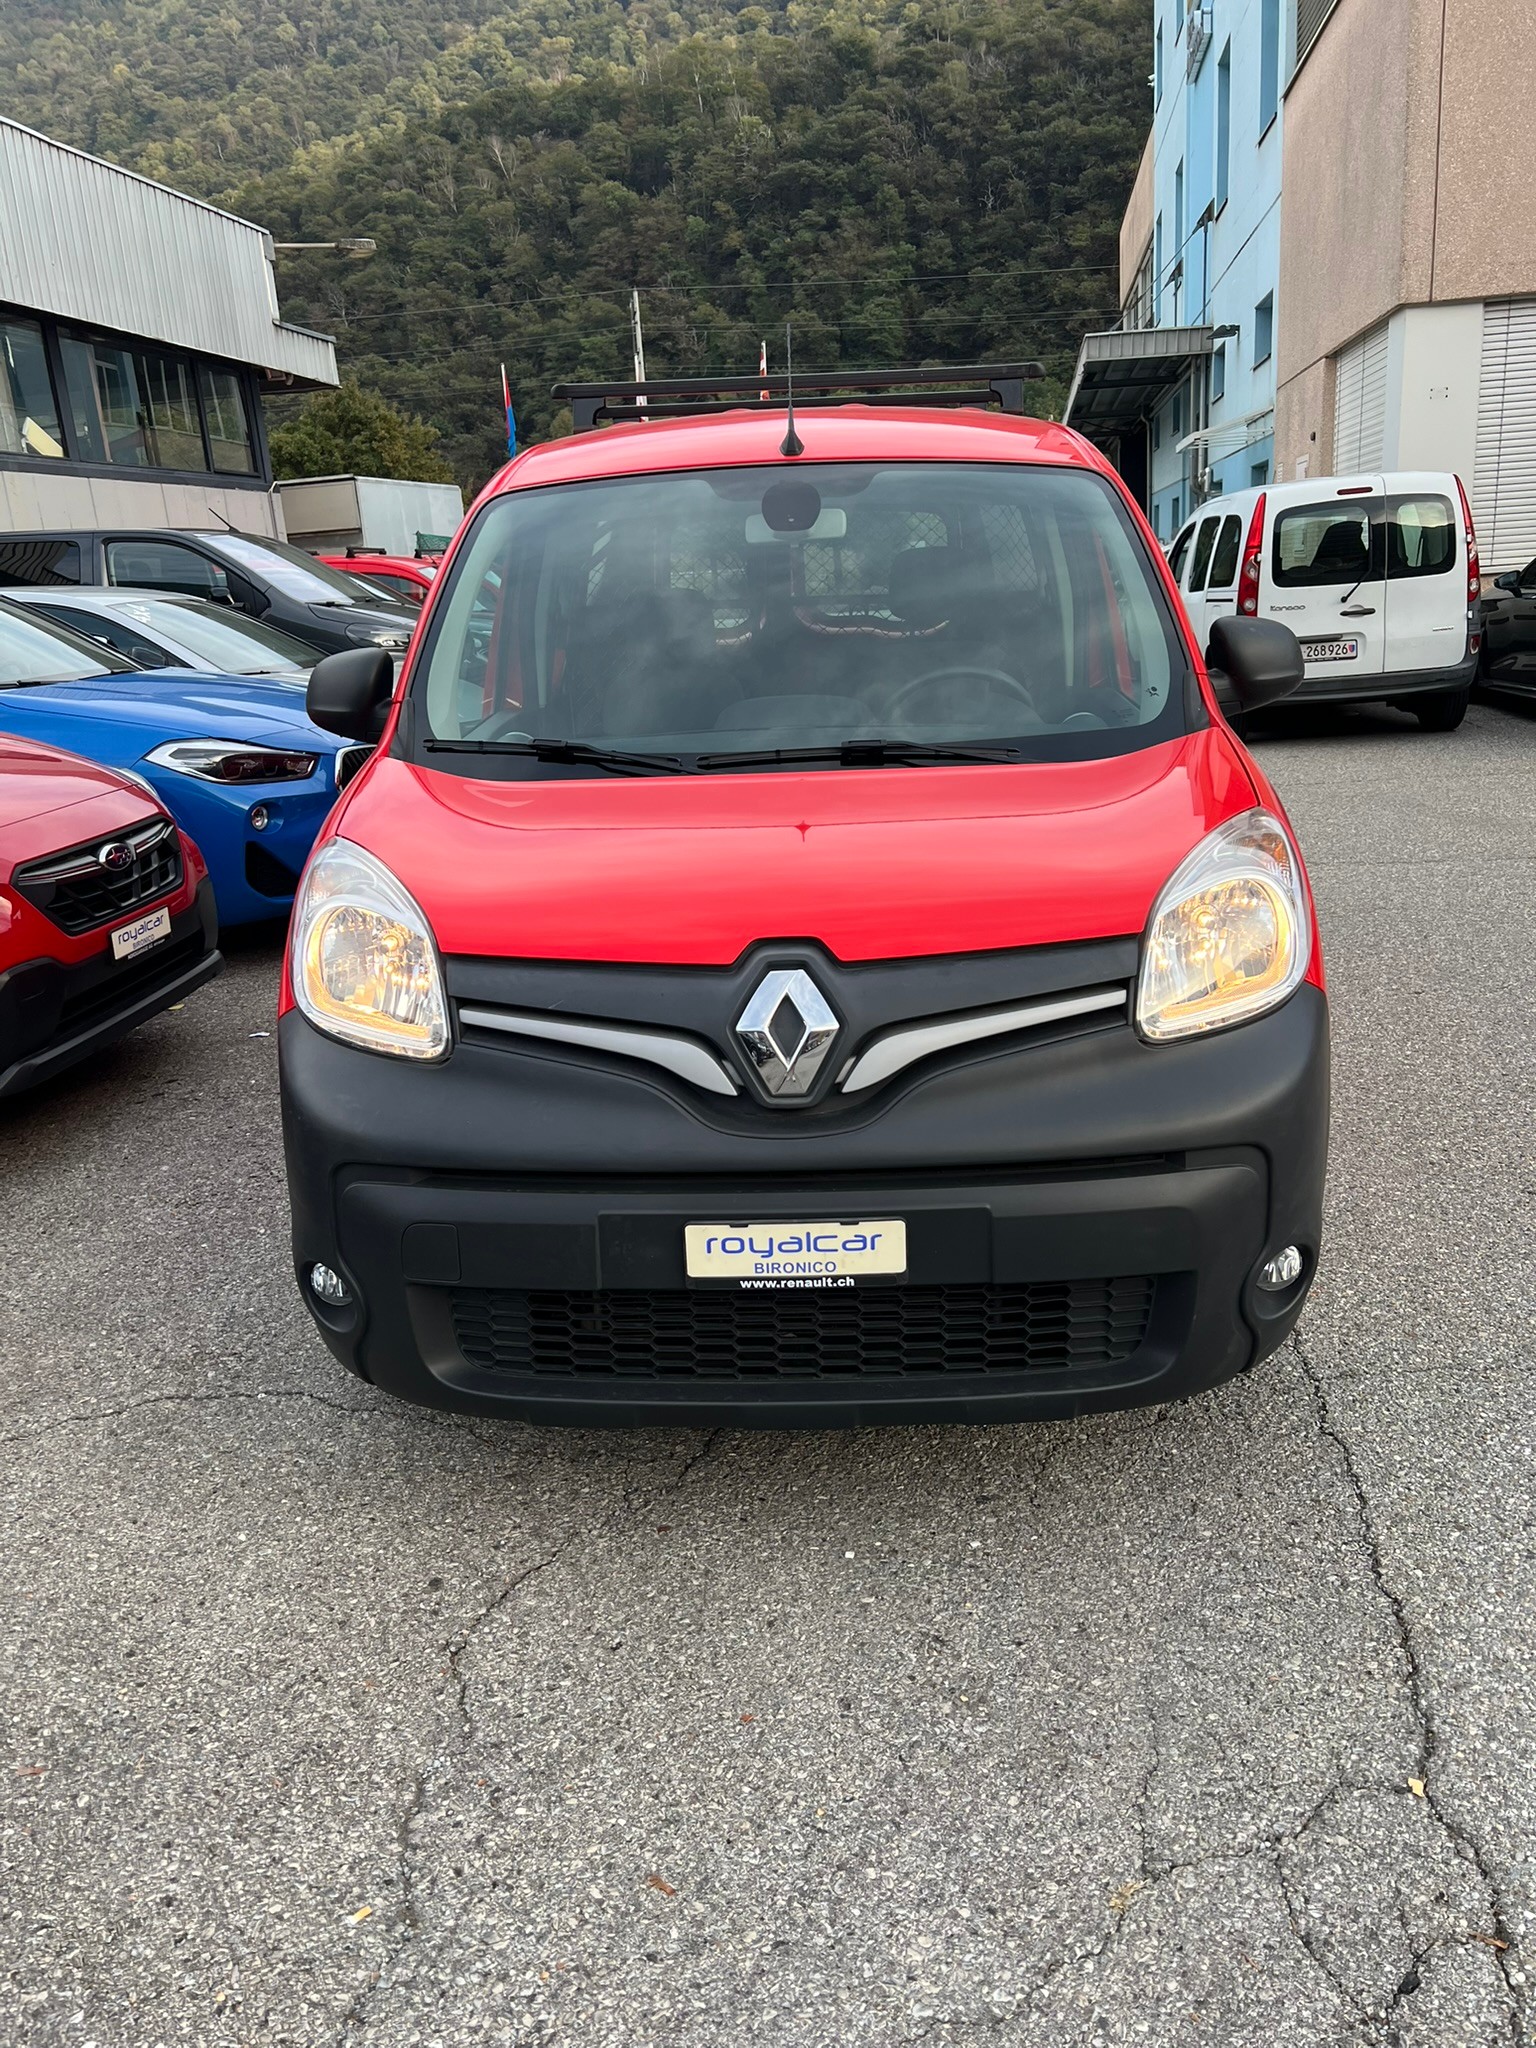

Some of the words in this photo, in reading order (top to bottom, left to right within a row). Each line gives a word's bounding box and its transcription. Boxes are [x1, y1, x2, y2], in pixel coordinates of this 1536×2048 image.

[117, 914, 164, 945] royalcar
[706, 1231, 883, 1258] royalcar
[754, 1261, 837, 1274] BIRONICO
[740, 1276, 855, 1289] www.renault.ch
